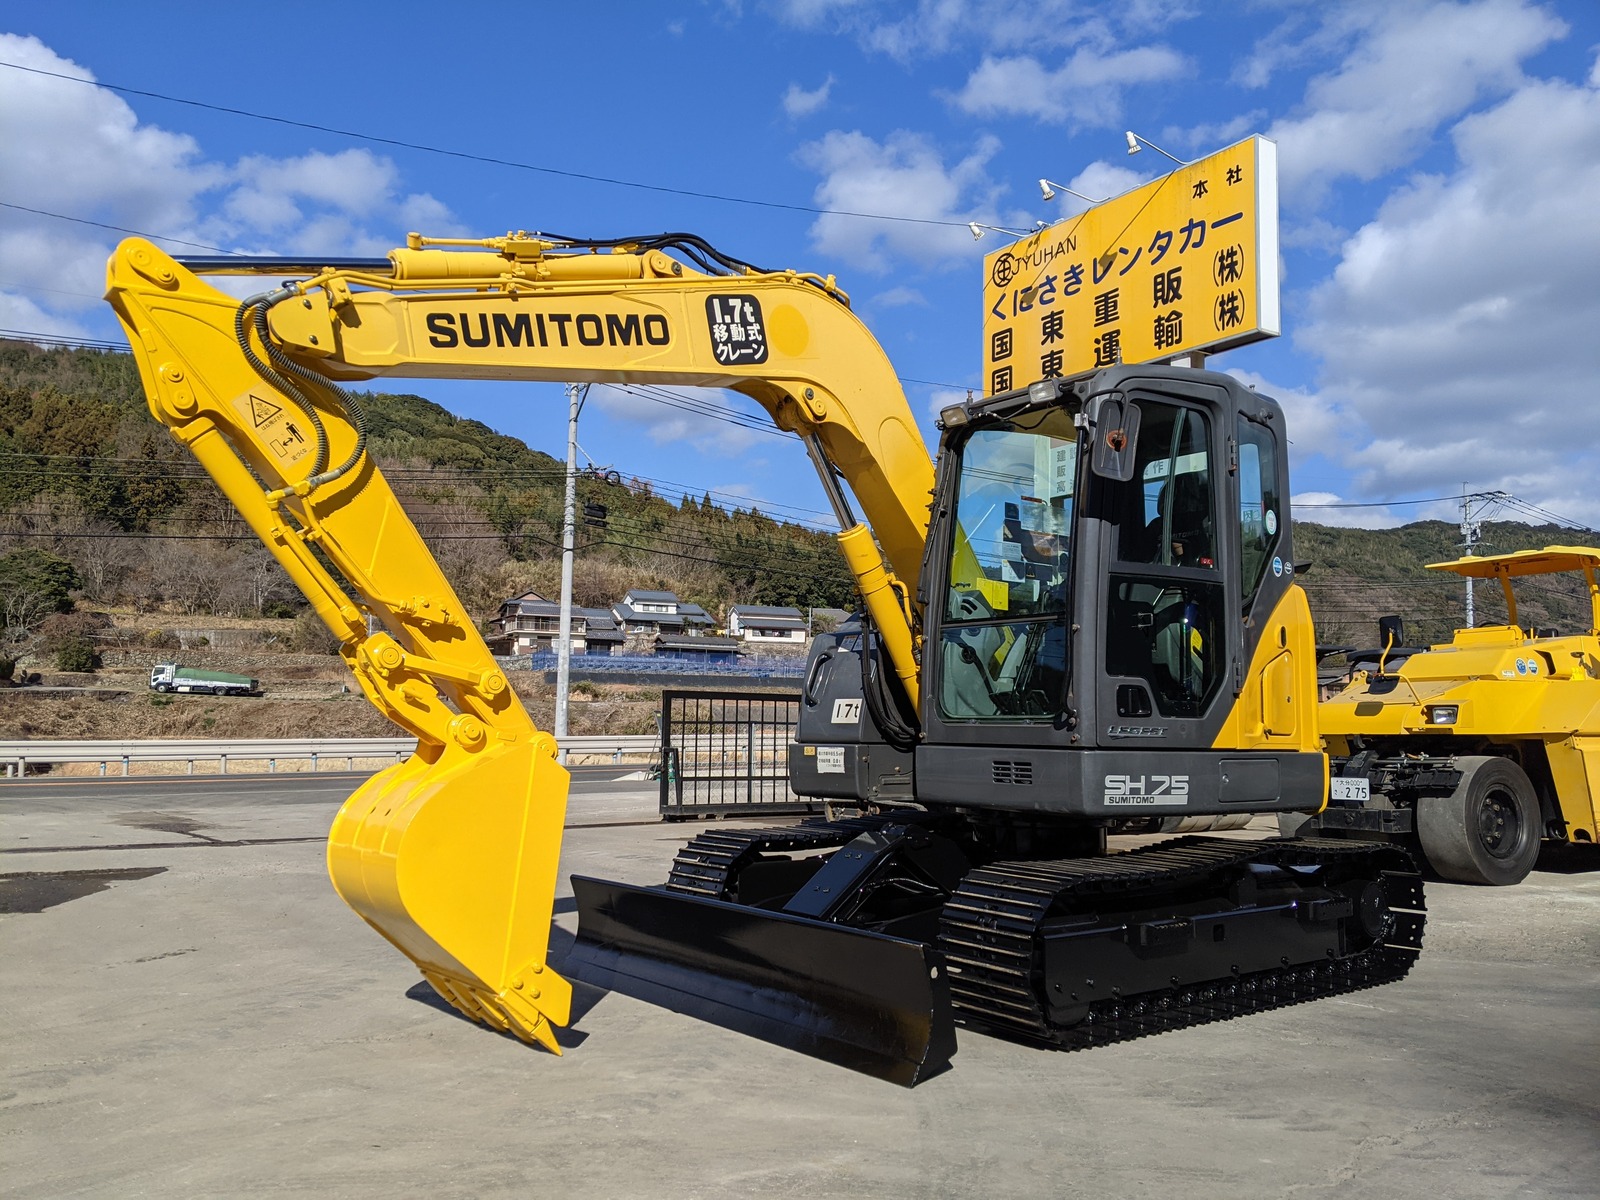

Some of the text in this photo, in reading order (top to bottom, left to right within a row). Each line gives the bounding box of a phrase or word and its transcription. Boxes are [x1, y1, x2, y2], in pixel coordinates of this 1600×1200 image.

[1192, 165, 1243, 199] 本社
[991, 212, 1243, 320] くにさきレンタカー
[1012, 235, 1077, 276] JYUHAN
[712, 298, 756, 323] 1.7t
[426, 313, 670, 348] SUMITOMO
[712, 324, 763, 342] 移動式
[716, 343, 765, 361] クレーン
[836, 704, 859, 718] 1.7t
[1108, 796, 1155, 804] SUMITOMO
